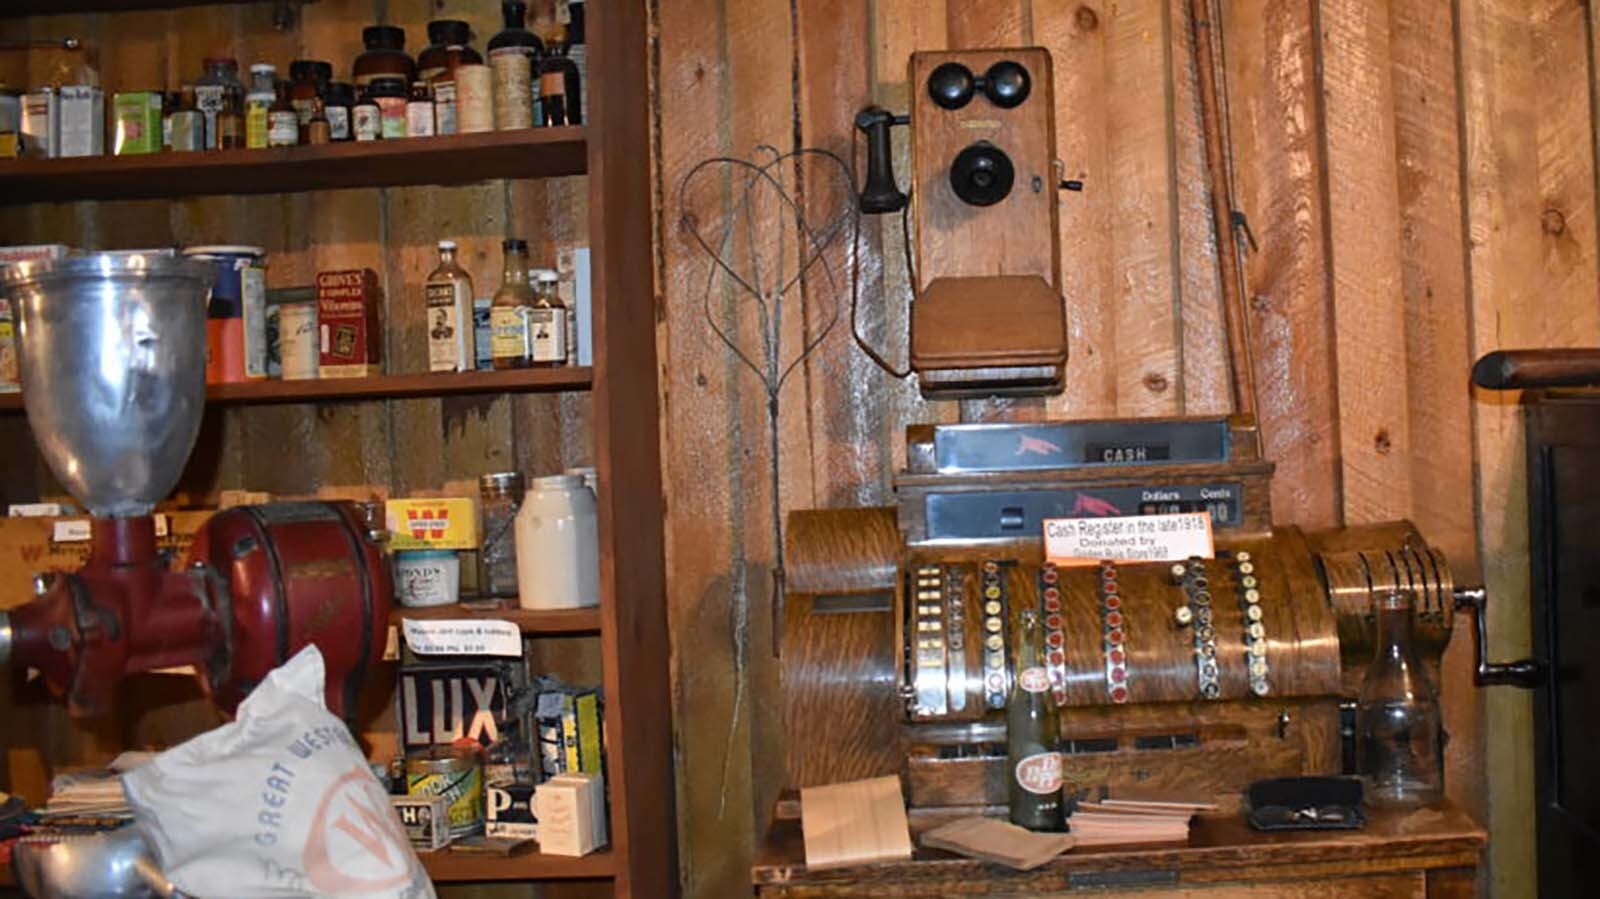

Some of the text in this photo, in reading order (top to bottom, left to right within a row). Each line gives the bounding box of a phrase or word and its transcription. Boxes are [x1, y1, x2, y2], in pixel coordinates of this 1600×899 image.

[1103, 448, 1147, 462] CASH
[1142, 488, 1231, 501] Dollars Cents
[1047, 521, 1076, 538] Cash
[1079, 519, 1124, 538] Register
[1137, 520, 1156, 533] the
[1079, 537, 1136, 547] Donated
[403, 676, 498, 745] LUX
[254, 761, 297, 848] GREAT
